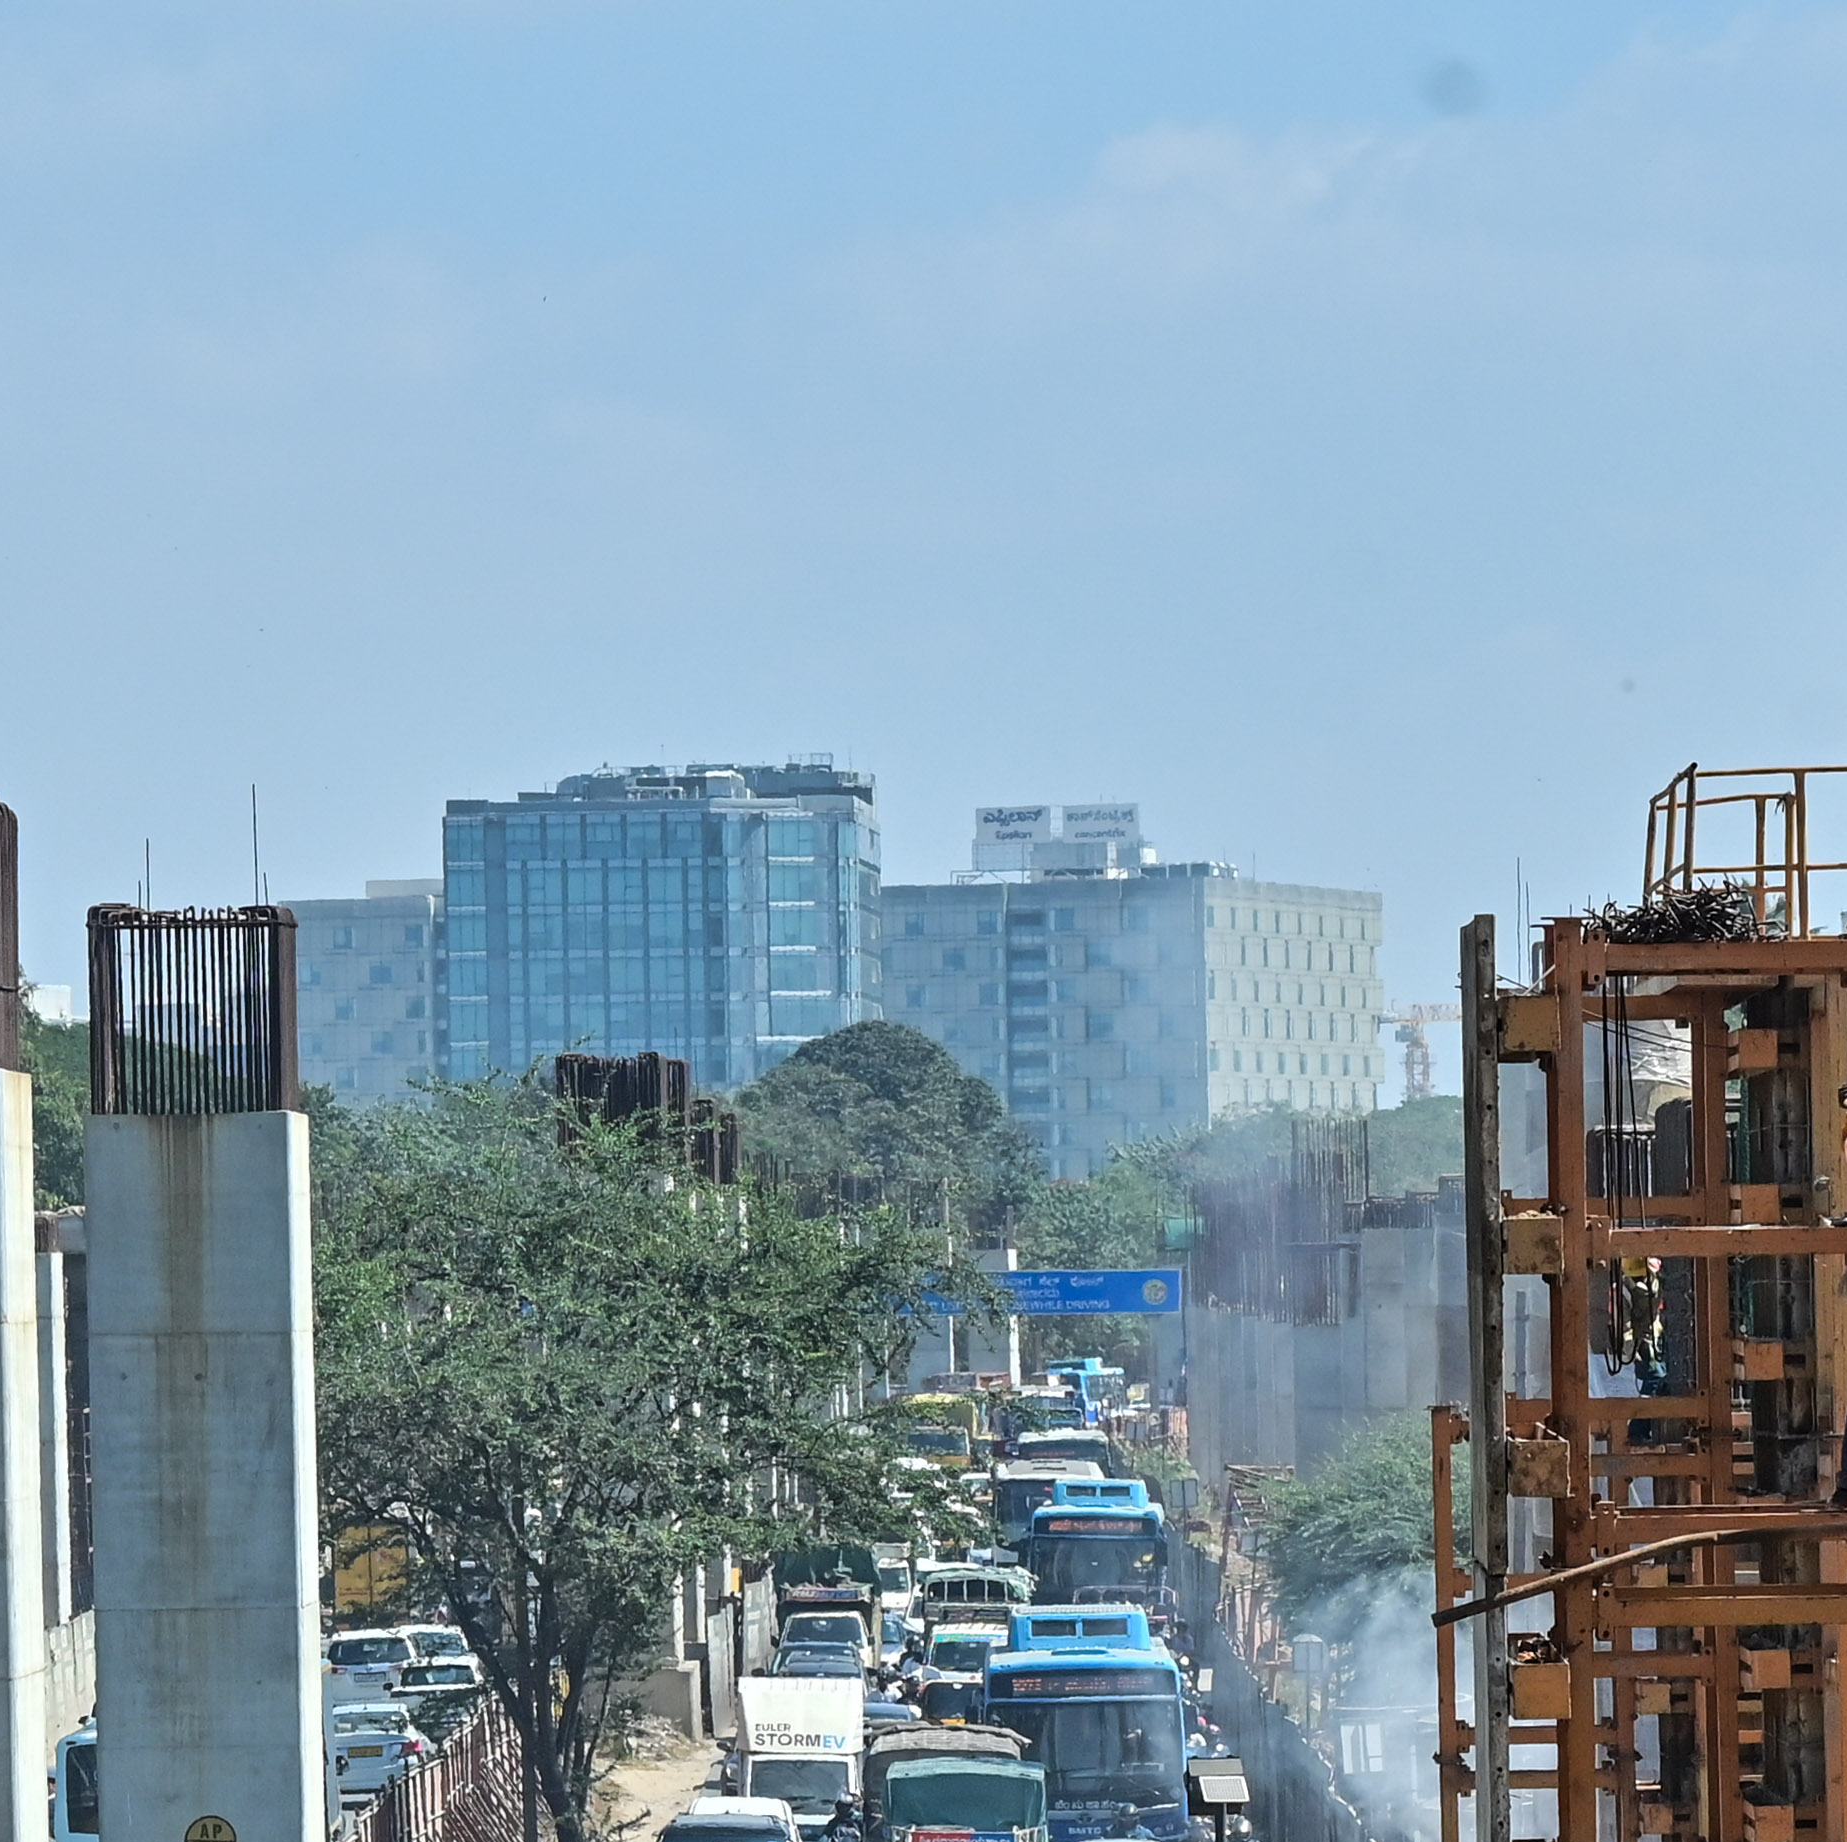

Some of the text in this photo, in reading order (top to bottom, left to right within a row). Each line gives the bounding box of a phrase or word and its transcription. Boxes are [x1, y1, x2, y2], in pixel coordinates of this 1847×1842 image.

[994, 830, 1033, 840] Epsilon
[1074, 828, 1126, 839] concentrix
[1065, 1299, 1110, 1310] DRIVING
[755, 1722, 791, 1732] EULER
[755, 1733, 846, 1749] STORMEV
[200, 1823, 222, 1839] AP
[1068, 1827, 1102, 1835] BMTC
